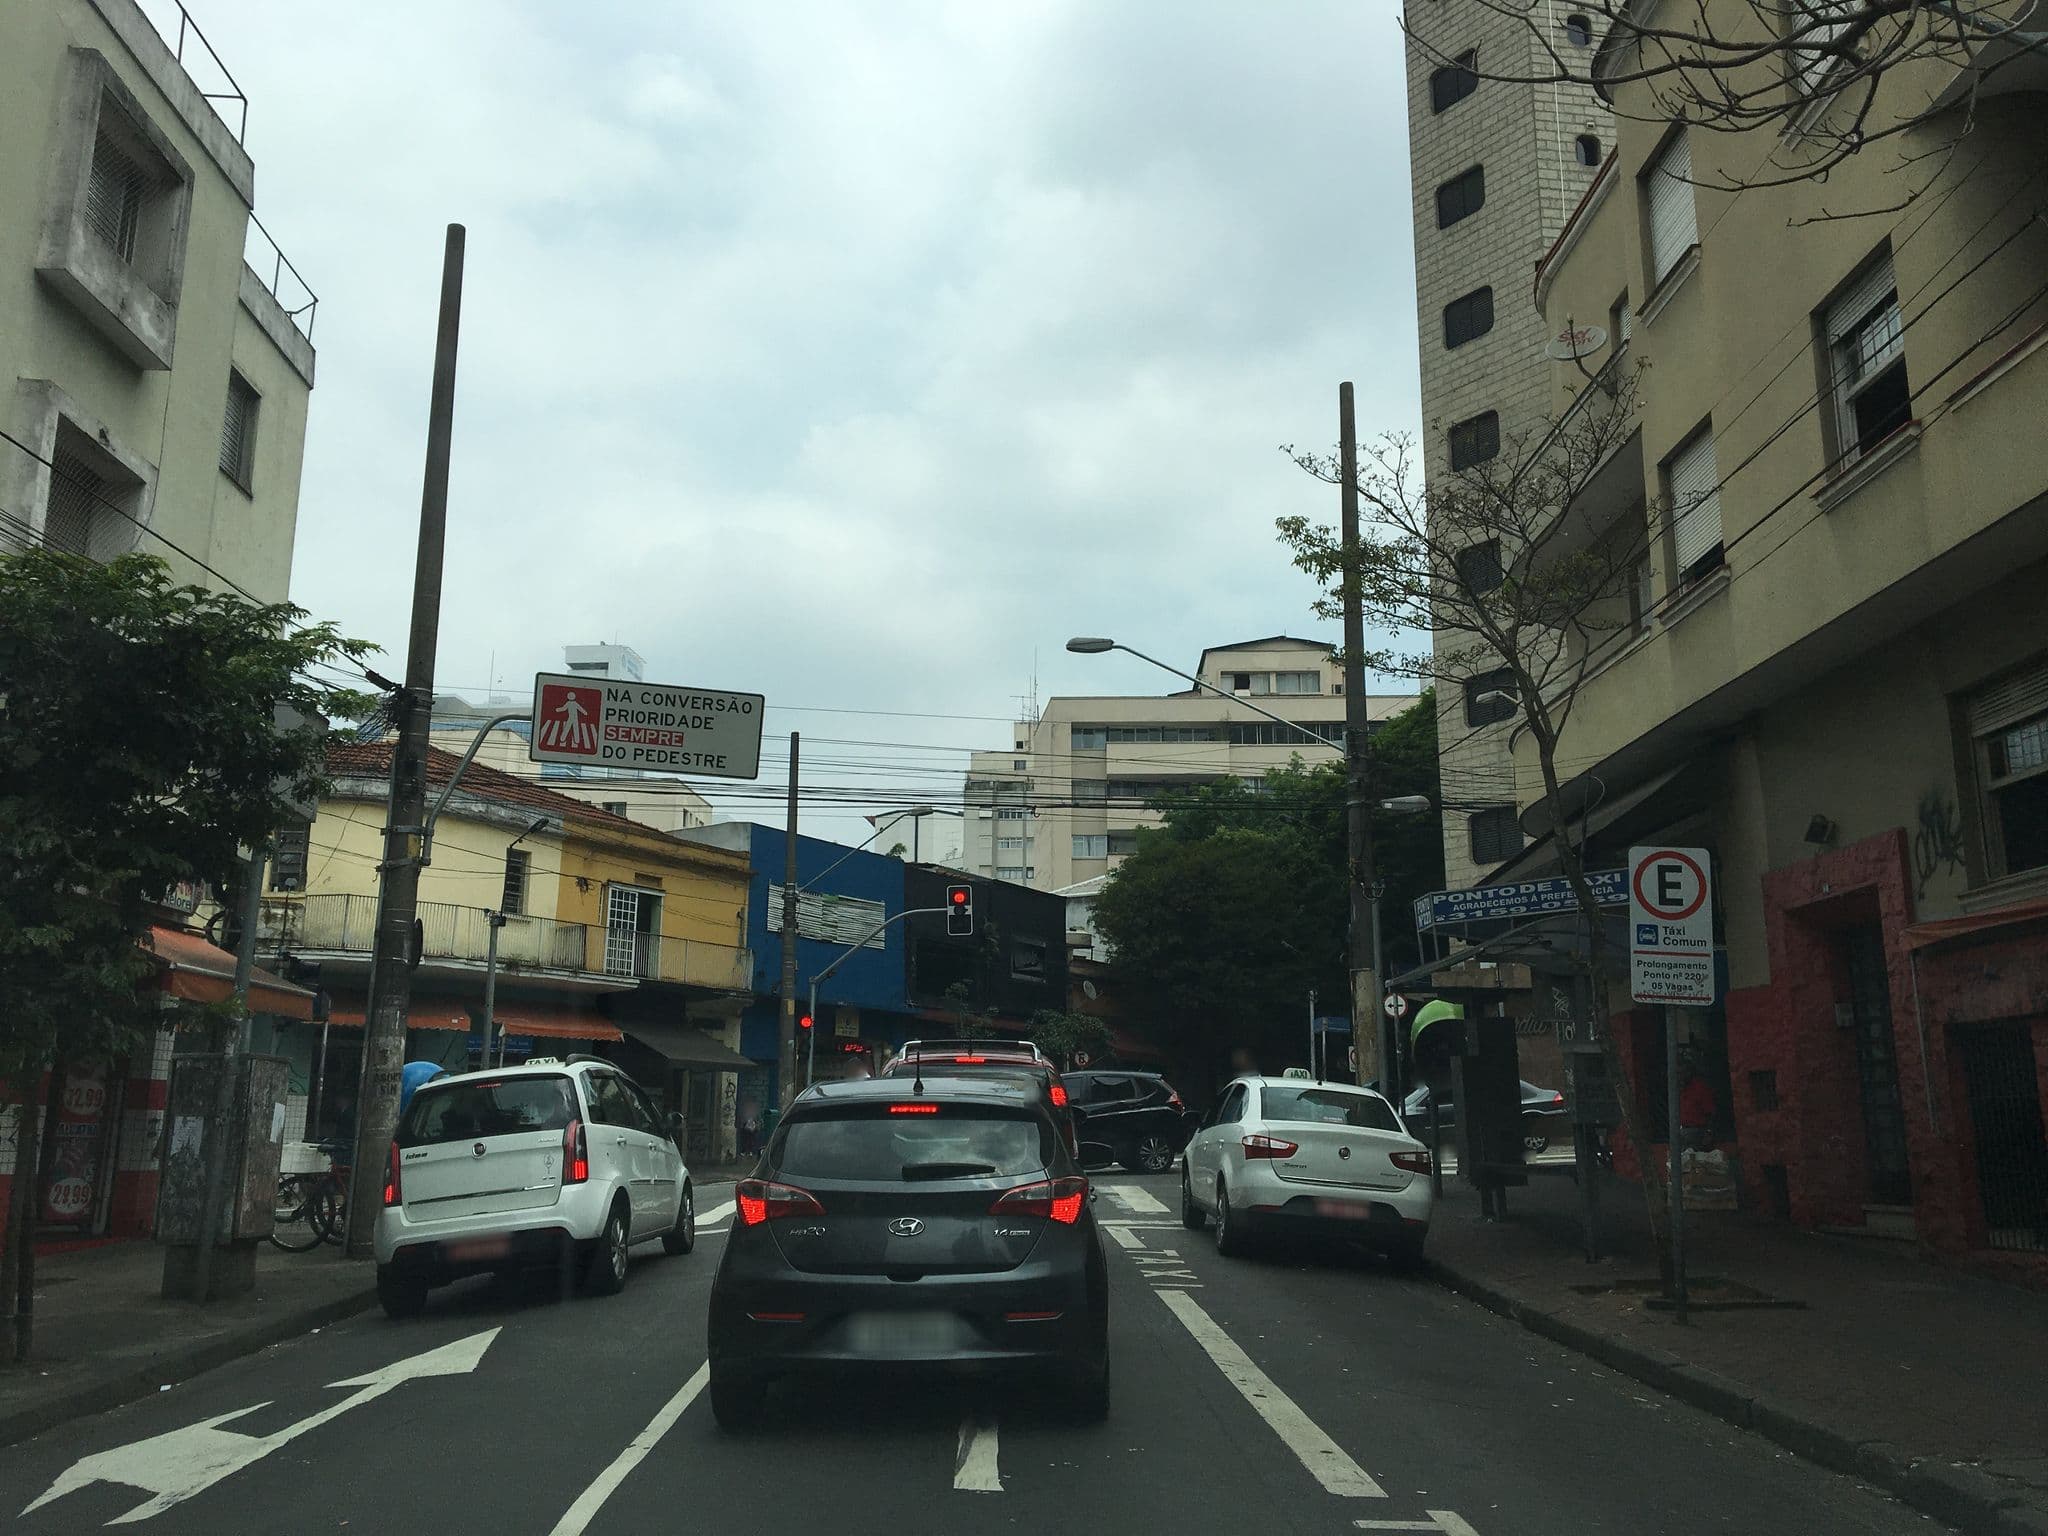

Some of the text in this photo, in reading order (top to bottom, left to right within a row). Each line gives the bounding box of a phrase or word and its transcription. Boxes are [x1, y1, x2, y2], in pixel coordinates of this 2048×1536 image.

[607, 688, 752, 714] NA CONVERSÃO
[605, 708, 714, 730] PRIORIDADE
[606, 727, 683, 746] SEMPRE
[603, 746, 727, 768] DO PEDESTRE
[1433, 888, 1516, 904] PONTO
[1519, 881, 1553, 894] DE
[1658, 864, 1683, 906] E
[1453, 895, 1528, 912] AGRADECEMOS
[1662, 925, 1686, 937] Táxi
[1663, 937, 1707, 948] Comum
[1637, 960, 1708, 971] Prolongamento
[1643, 971, 1671, 980] Ponto
[1684, 973, 1702, 982] 220
[1651, 982, 1693, 993] 05 Vagas
